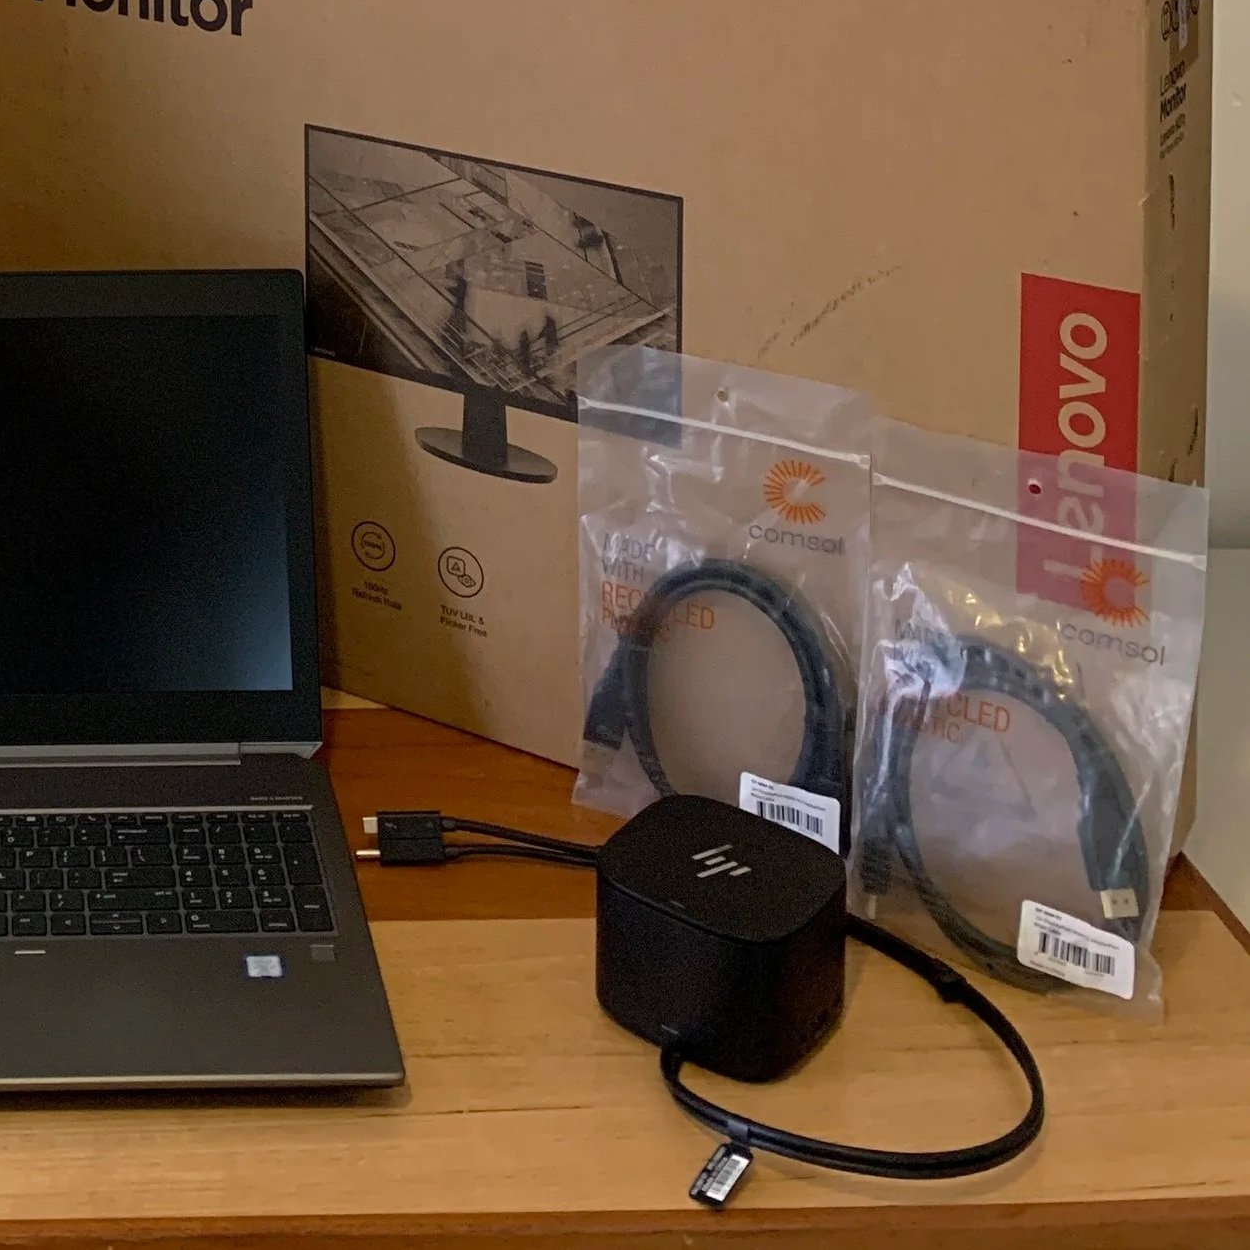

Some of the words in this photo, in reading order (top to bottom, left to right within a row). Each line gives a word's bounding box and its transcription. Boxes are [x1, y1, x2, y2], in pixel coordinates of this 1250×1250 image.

[1159, 60, 1187, 96] Lenovo
[1159, 83, 1187, 124] Monitor
[748, 524, 846, 556] comsol
[601, 559, 646, 583] WITH
[1060, 622, 1166, 666] comsol
